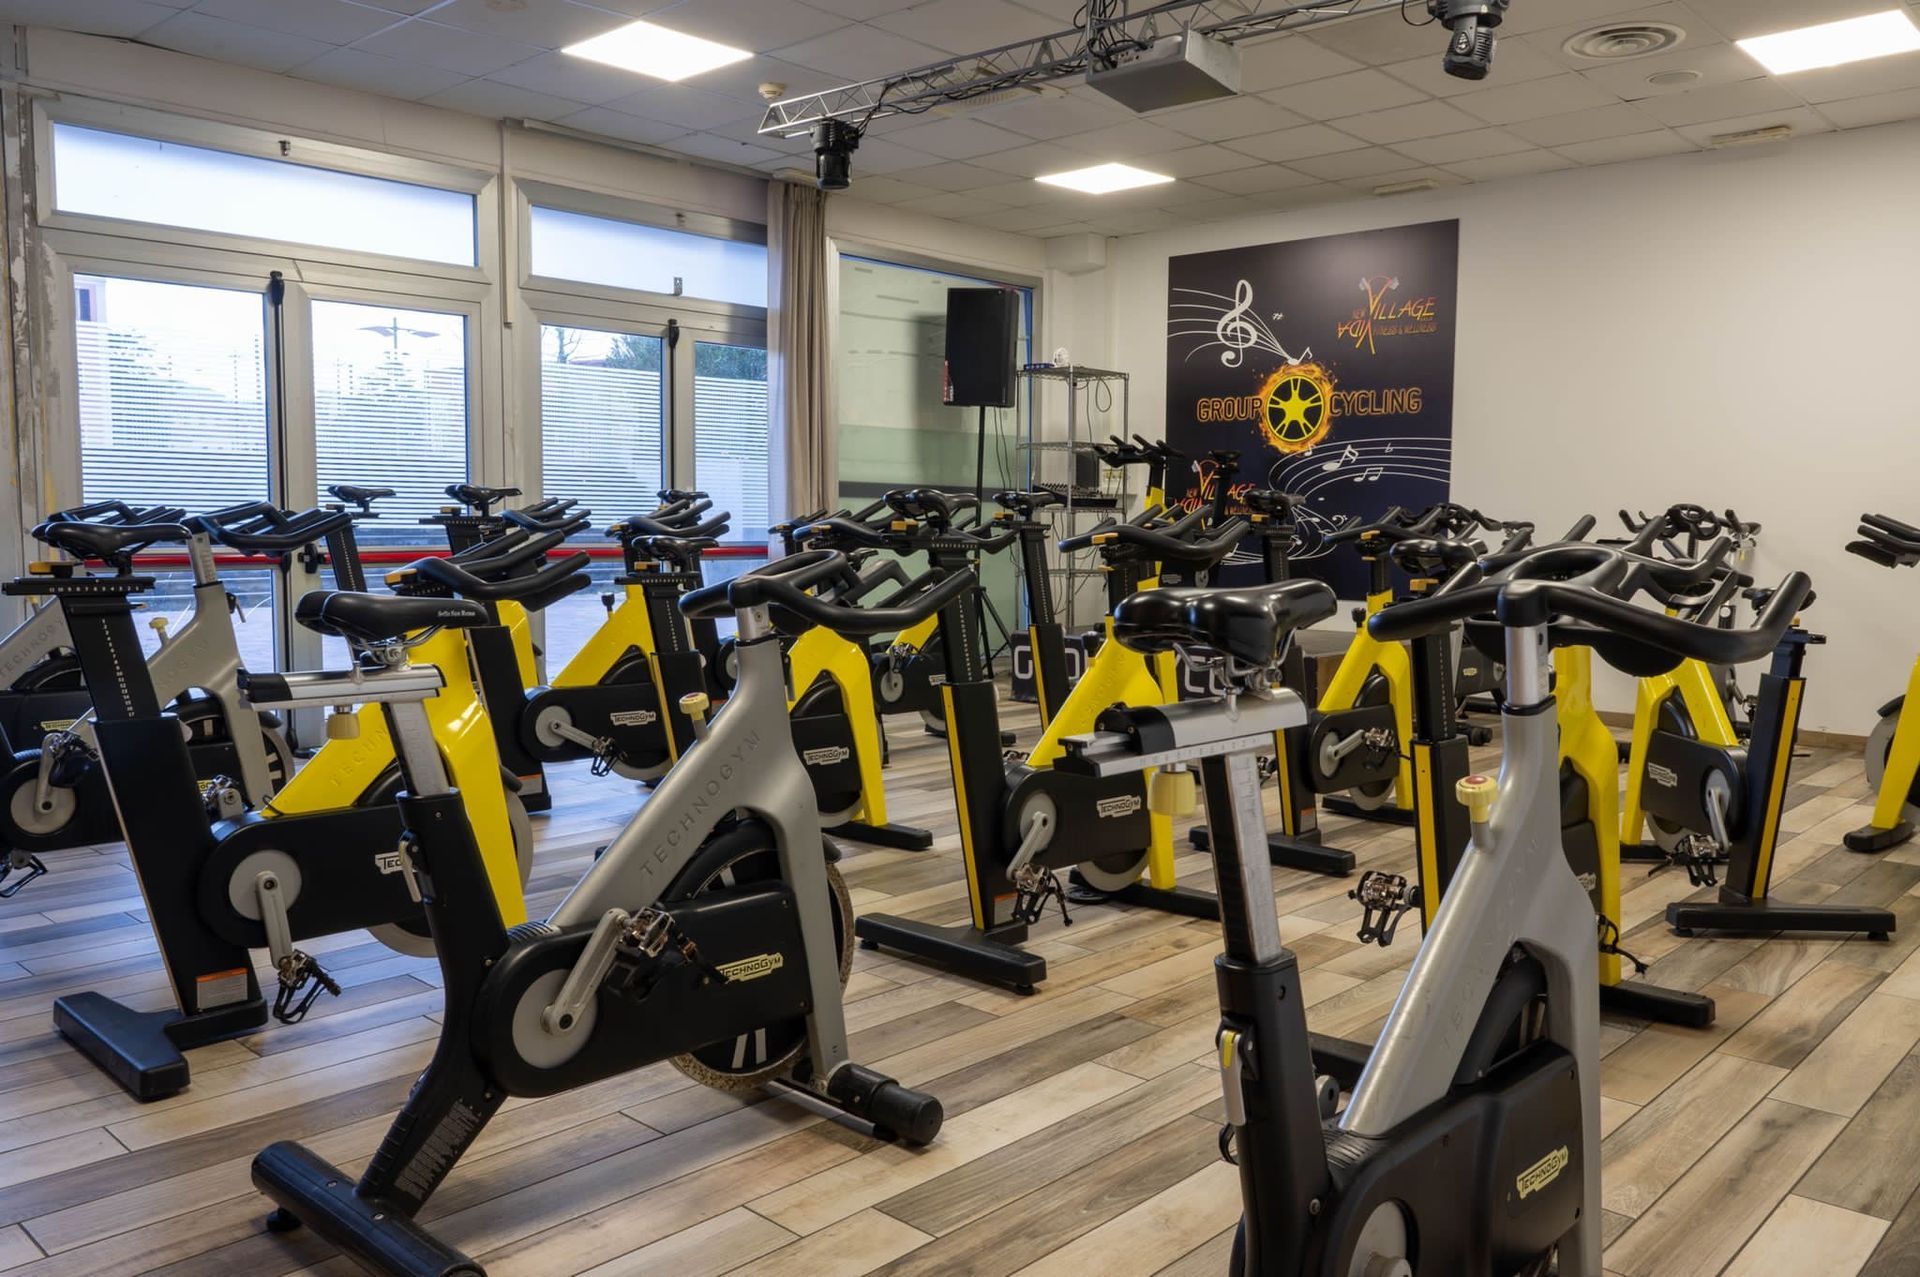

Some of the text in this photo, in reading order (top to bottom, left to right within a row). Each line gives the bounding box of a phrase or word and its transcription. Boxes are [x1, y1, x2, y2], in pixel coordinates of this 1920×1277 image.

[1361, 277, 1437, 321] VILLAGE
[1197, 387, 1423, 421] GROUP CYCLING
[640, 729, 760, 877] TECHNOGYM
